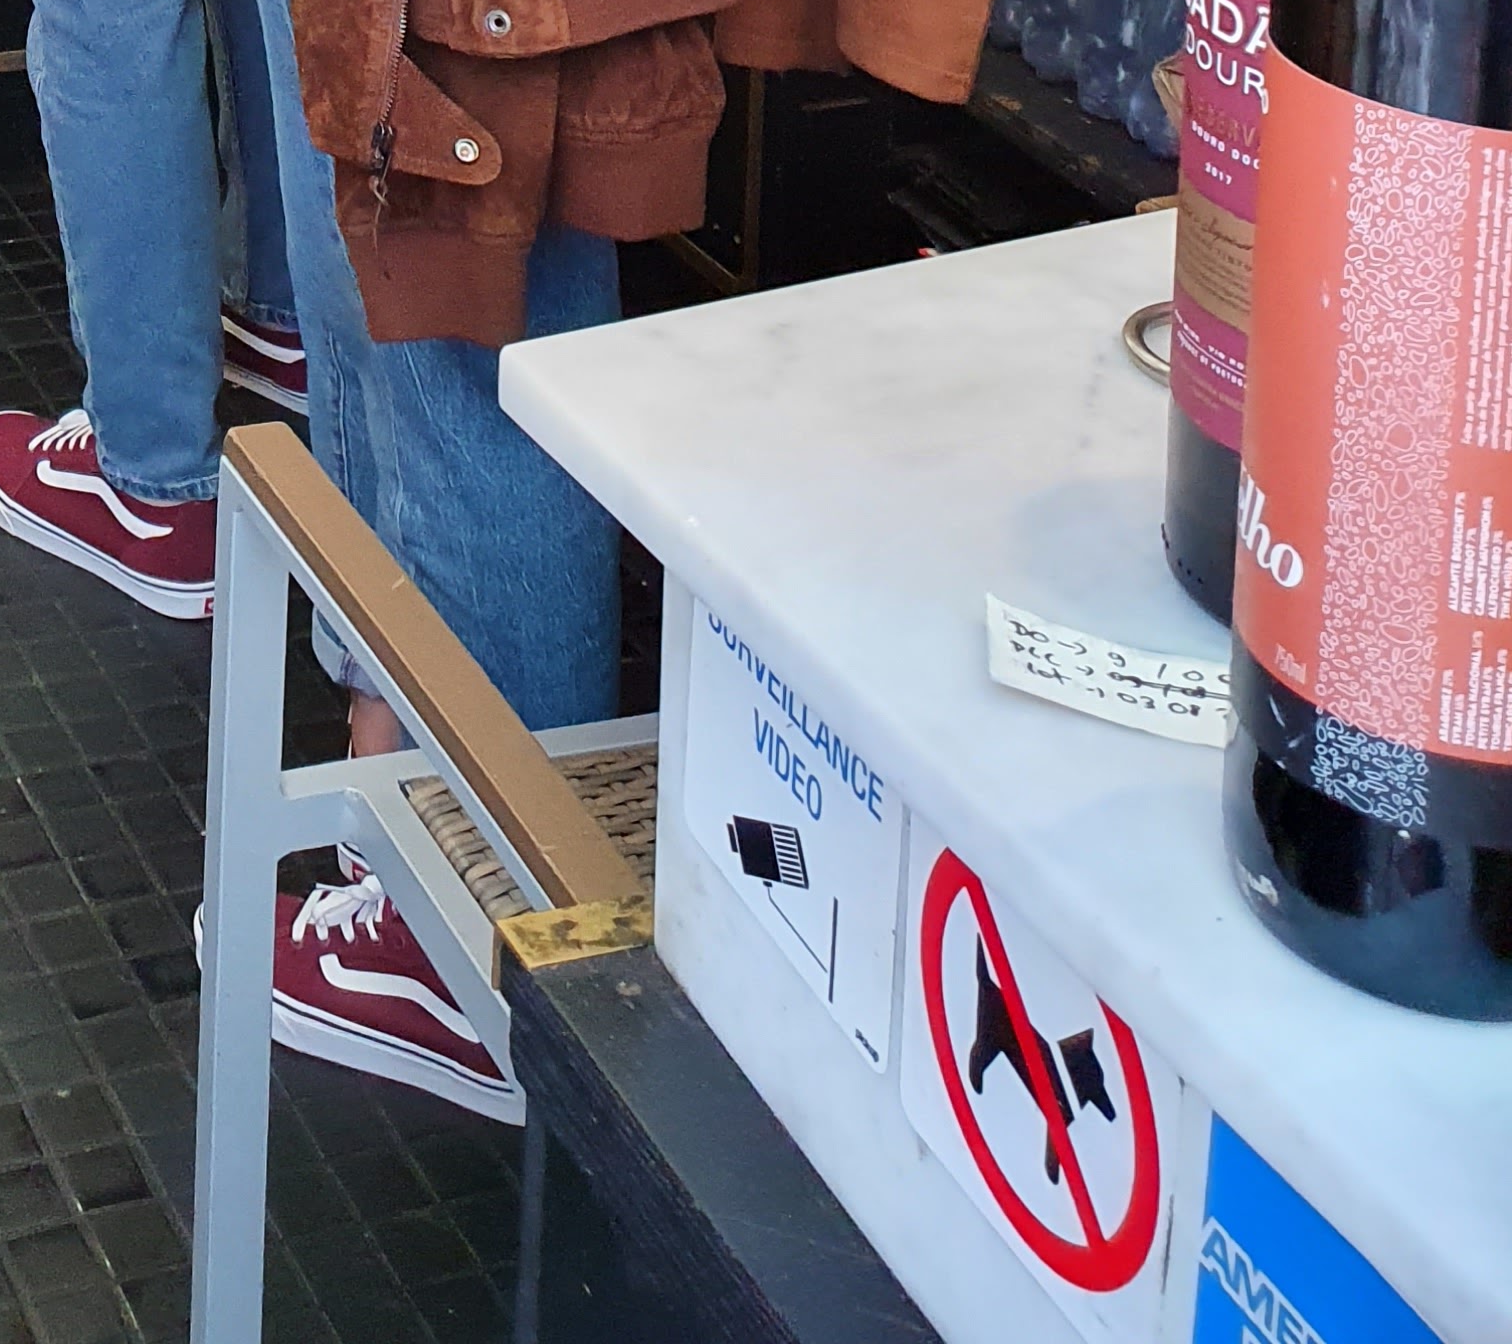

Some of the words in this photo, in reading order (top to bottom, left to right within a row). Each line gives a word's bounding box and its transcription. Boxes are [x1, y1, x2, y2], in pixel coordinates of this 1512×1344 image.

[1191, 119, 1226, 153] DOURO
[1204, 161, 1233, 186] 2017
[1239, 462, 1305, 589] lho
[1460, 586, 1472, 614] PETIT
[753, 706, 823, 822] VIDEO
[1200, 1220, 1324, 1344] AME
